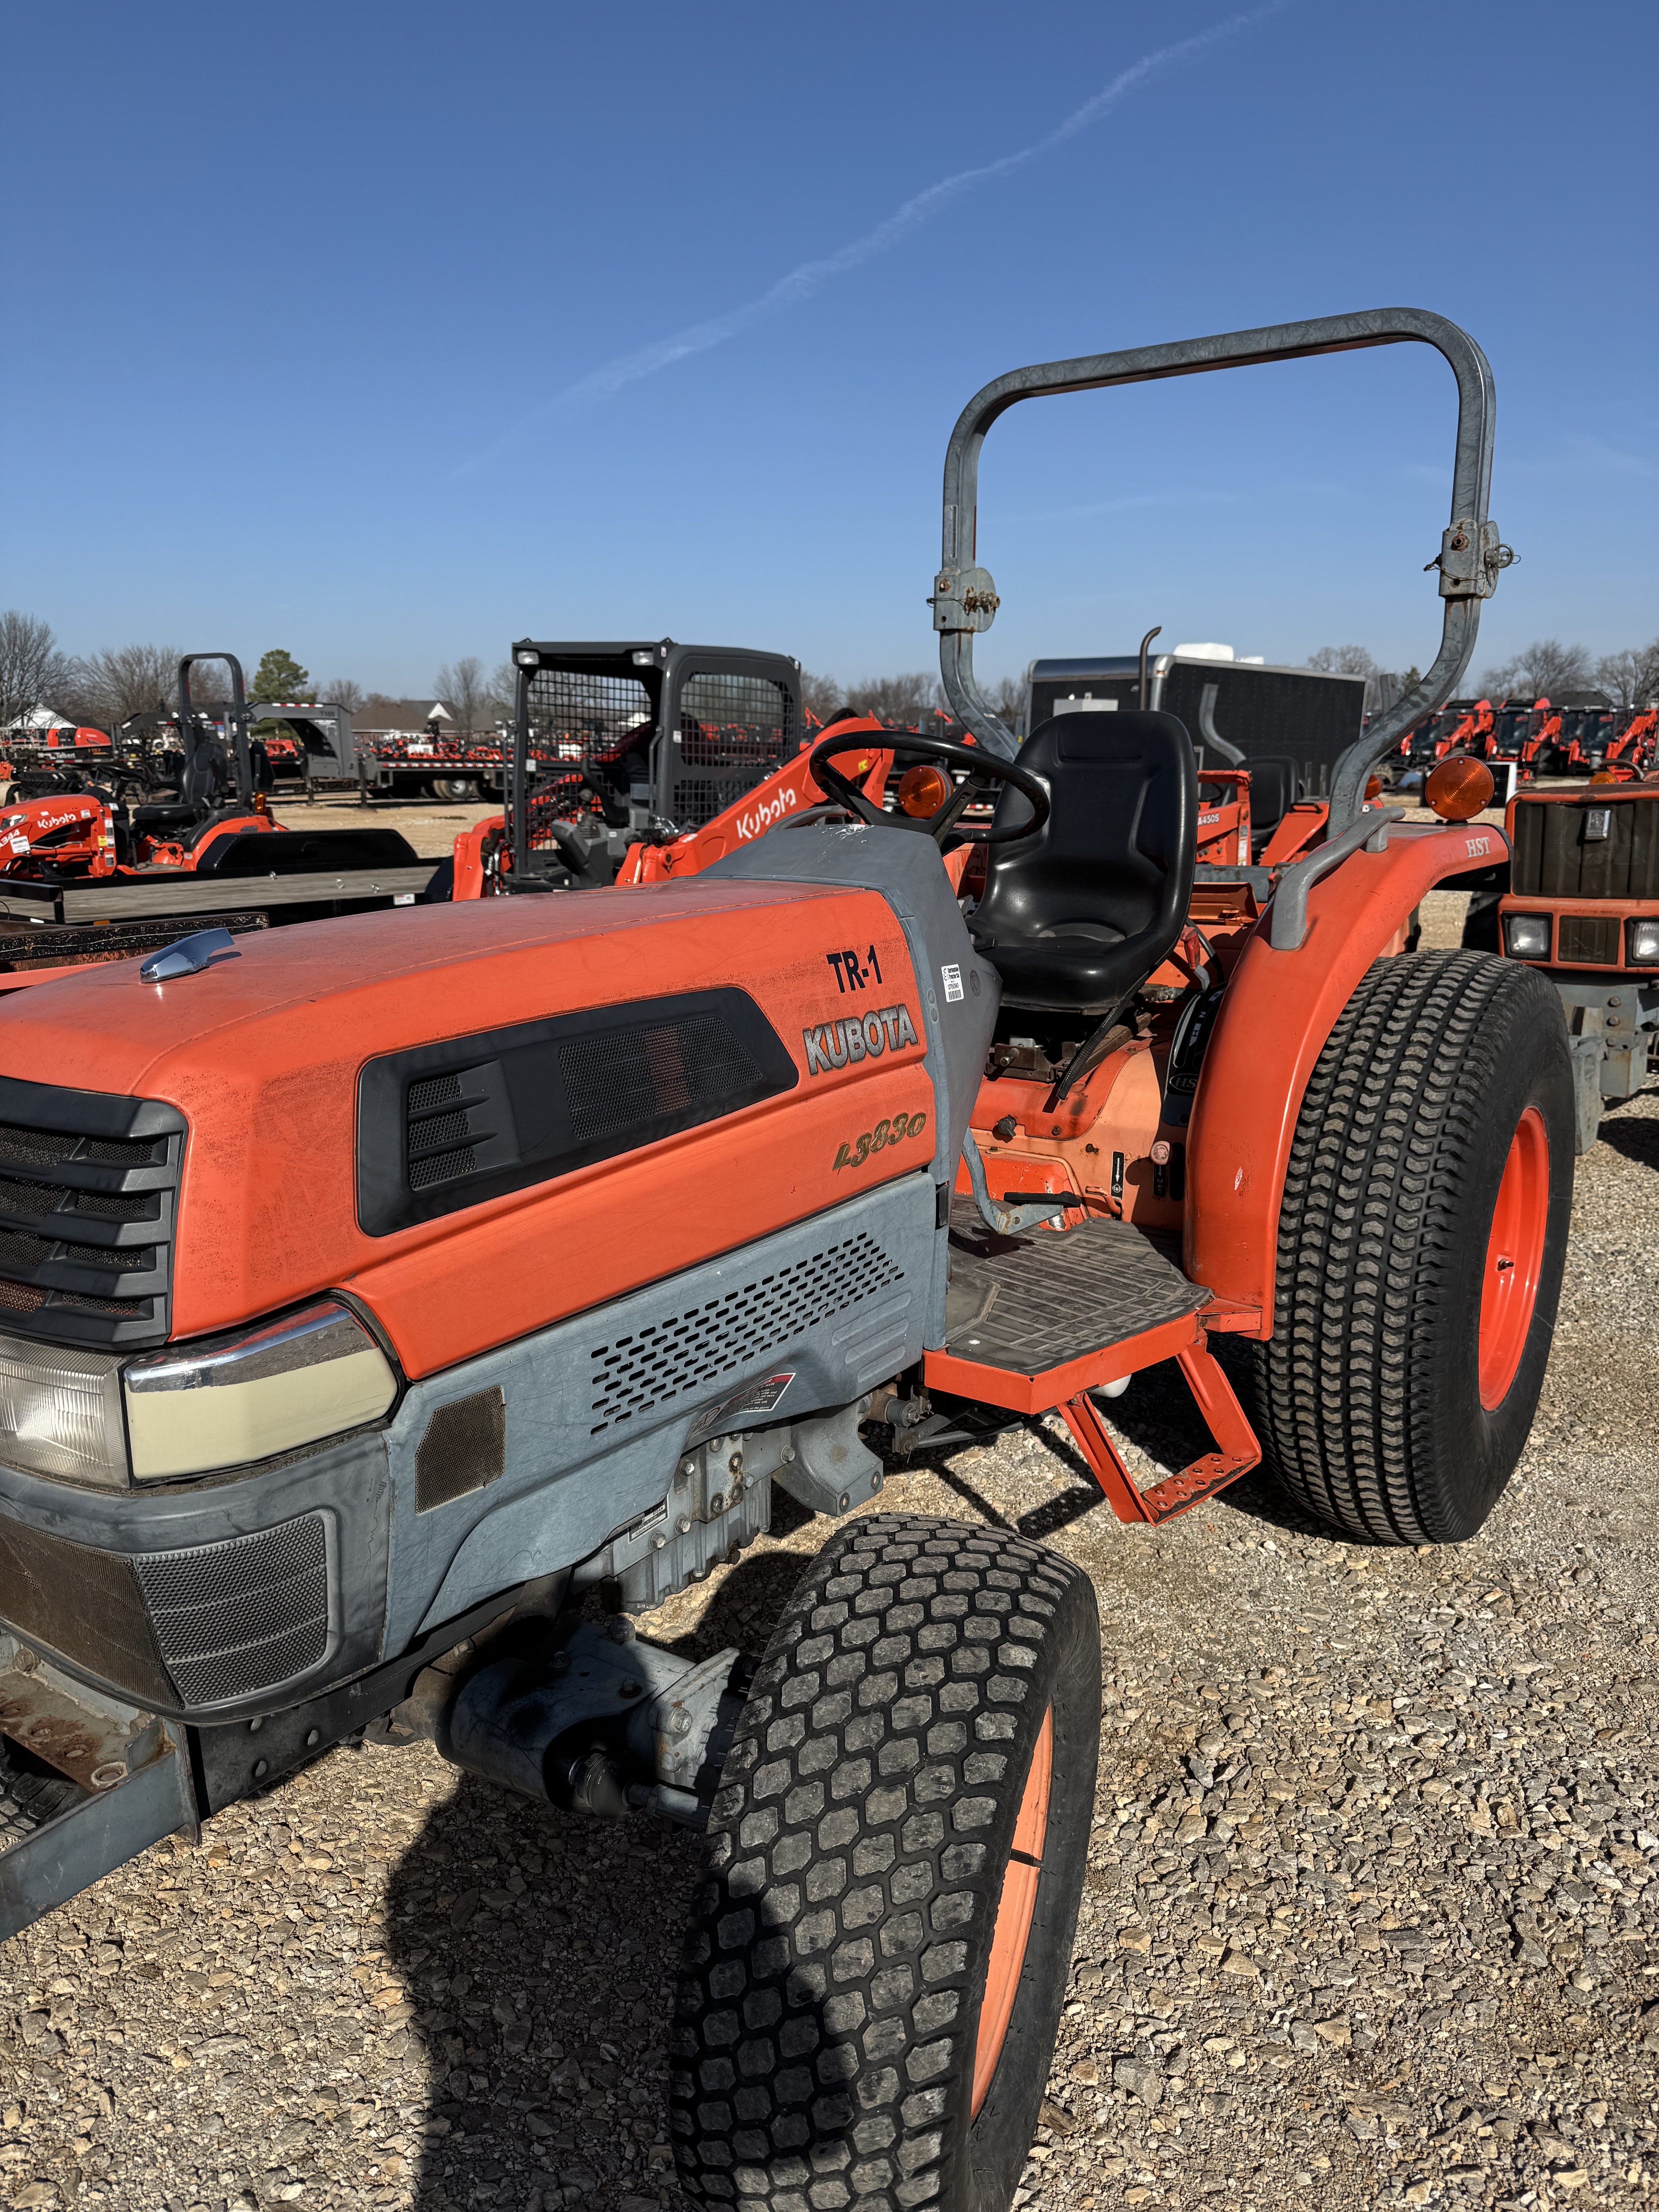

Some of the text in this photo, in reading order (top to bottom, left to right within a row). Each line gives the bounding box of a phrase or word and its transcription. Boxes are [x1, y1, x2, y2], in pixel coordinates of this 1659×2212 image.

[37, 813, 76, 829] Kubota
[736, 788, 796, 839] Kubota
[1465, 837, 1490, 858] HST
[826, 945, 882, 993] TR-1
[802, 1003, 919, 1076] KUBOTA
[1174, 1077, 1197, 1088] HS
